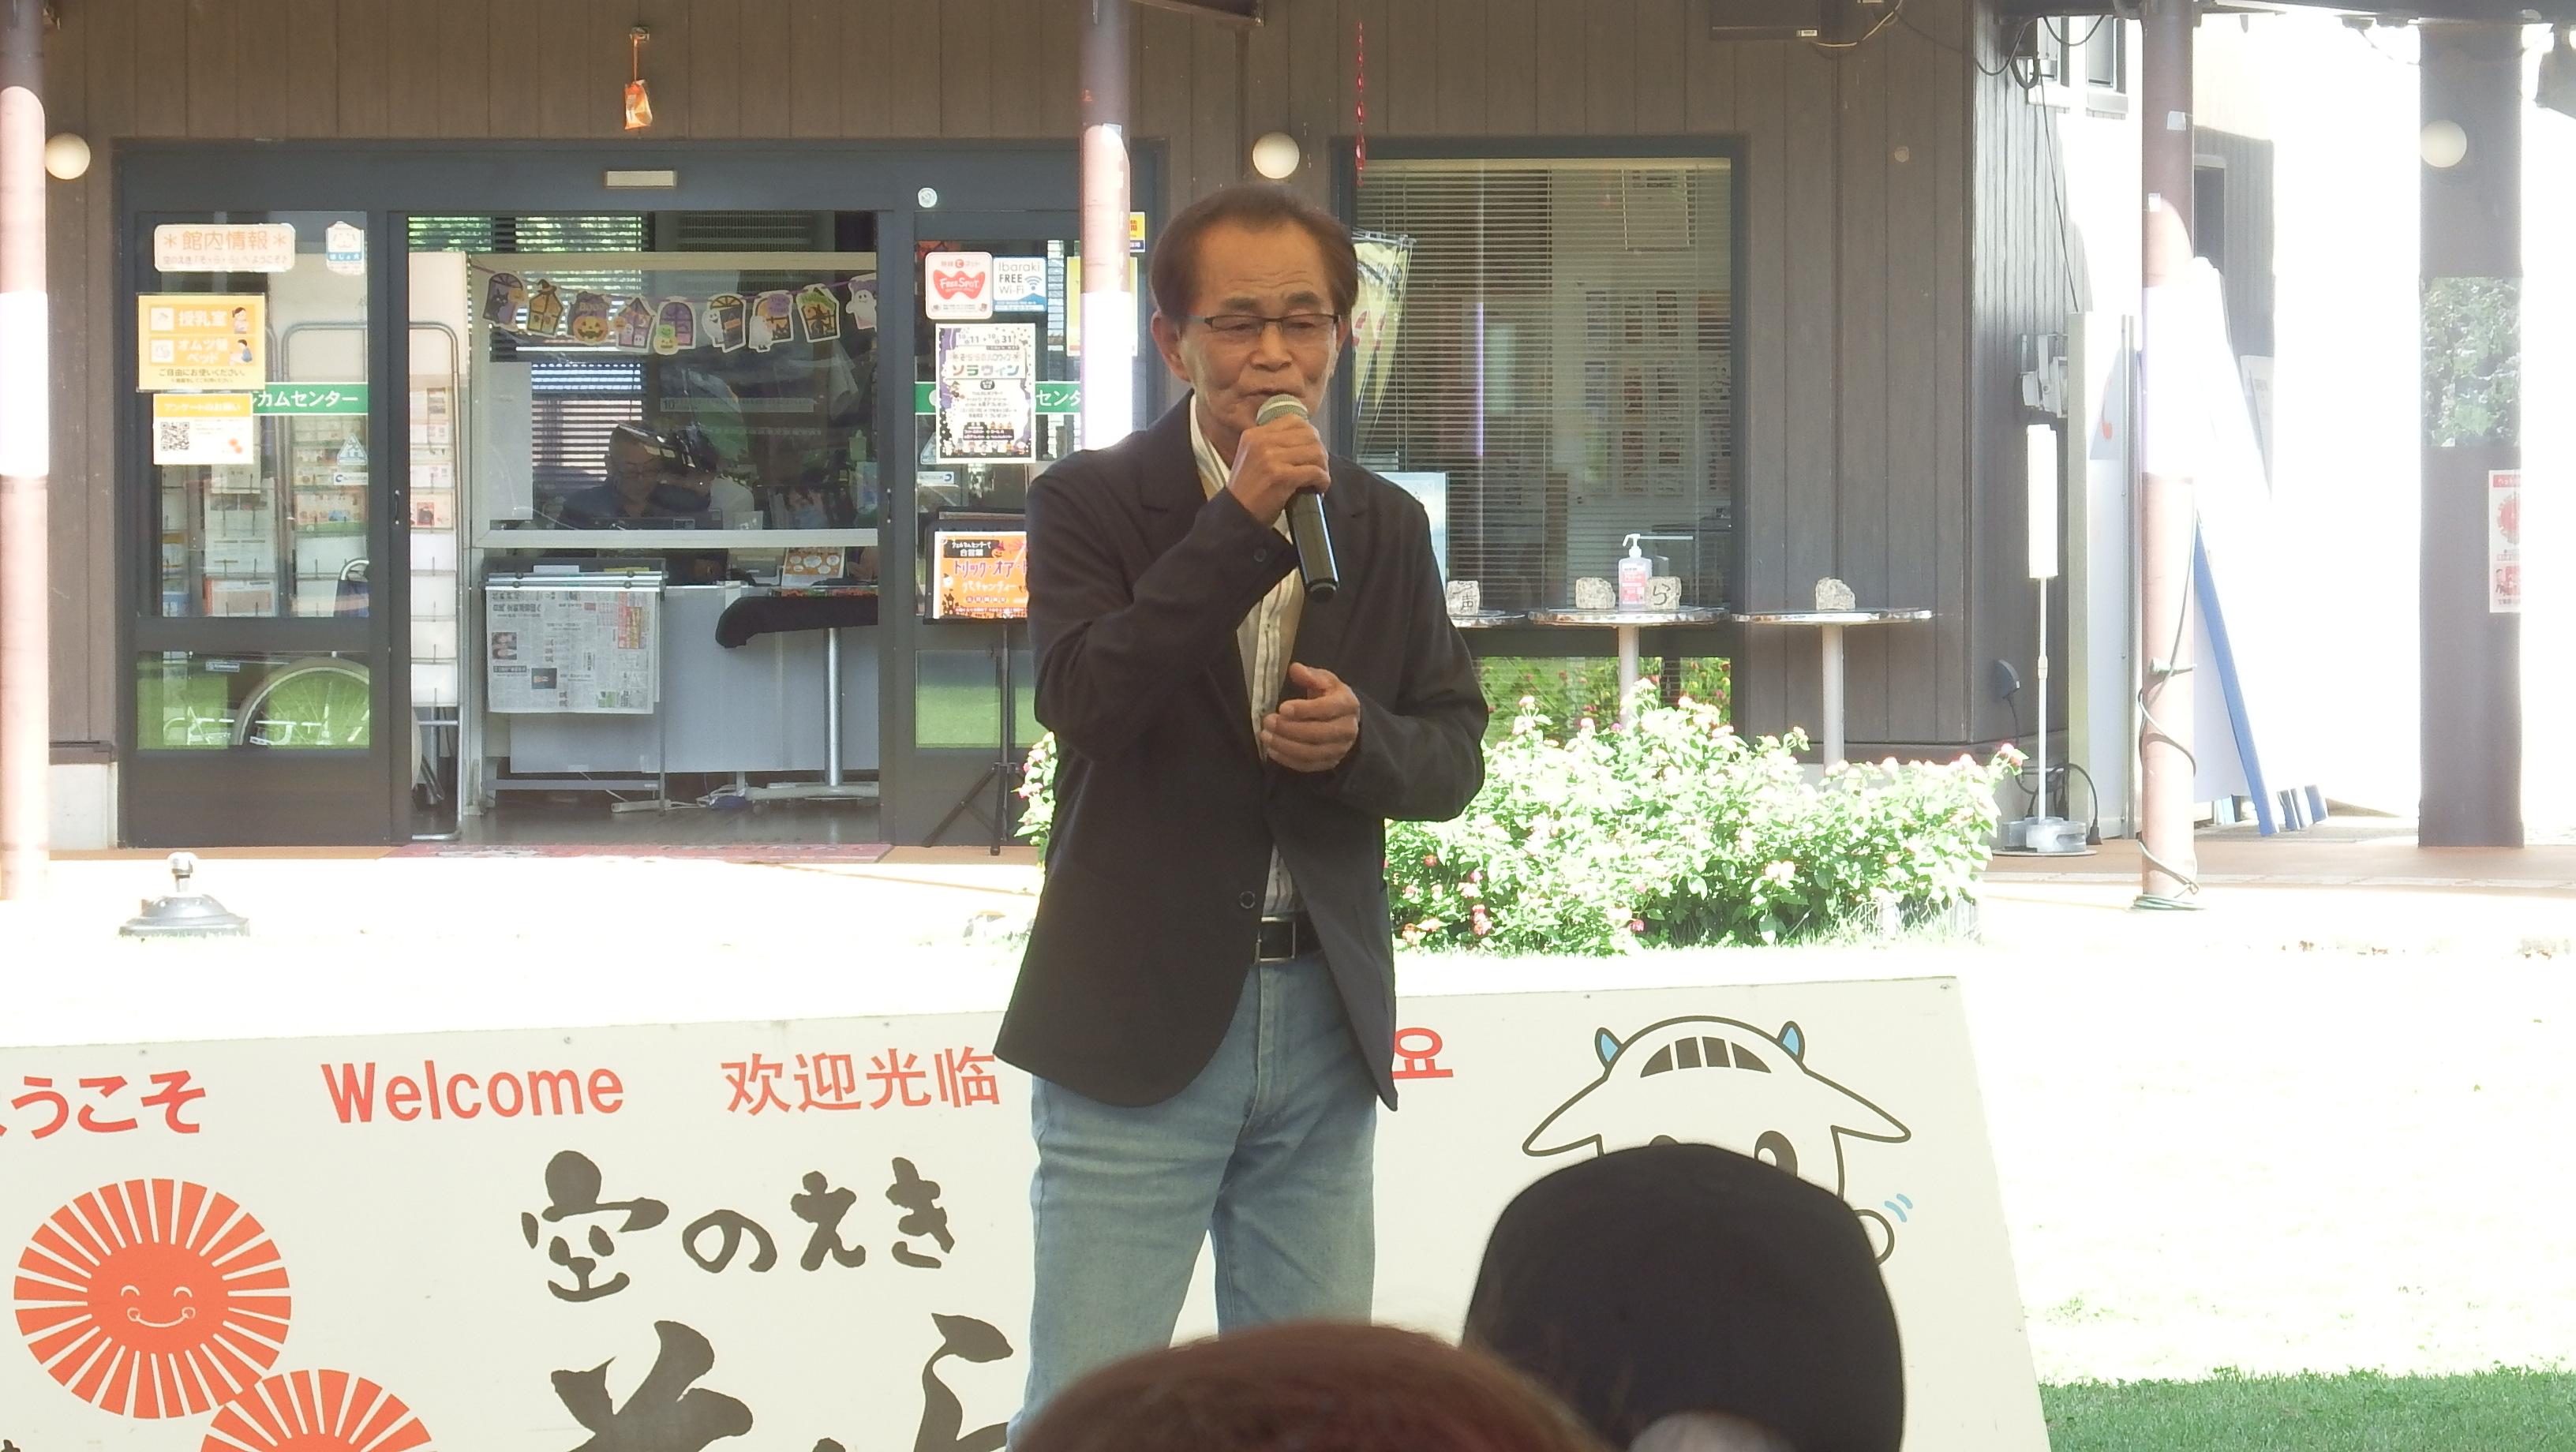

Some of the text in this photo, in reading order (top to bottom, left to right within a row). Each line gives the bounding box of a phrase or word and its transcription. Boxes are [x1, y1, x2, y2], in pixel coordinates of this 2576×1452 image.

[182, 230, 268, 250] 館内情報
[998, 261, 1040, 271] Ibaraki
[999, 274, 1022, 283] FREE
[999, 285, 1024, 294] Wi-Fi
[320, 1059, 624, 1124] Welcome
[721, 1045, 1002, 1116] 欢迎光临
[0, 1070, 206, 1140] うこそ
[521, 1150, 955, 1302] 空のえき
